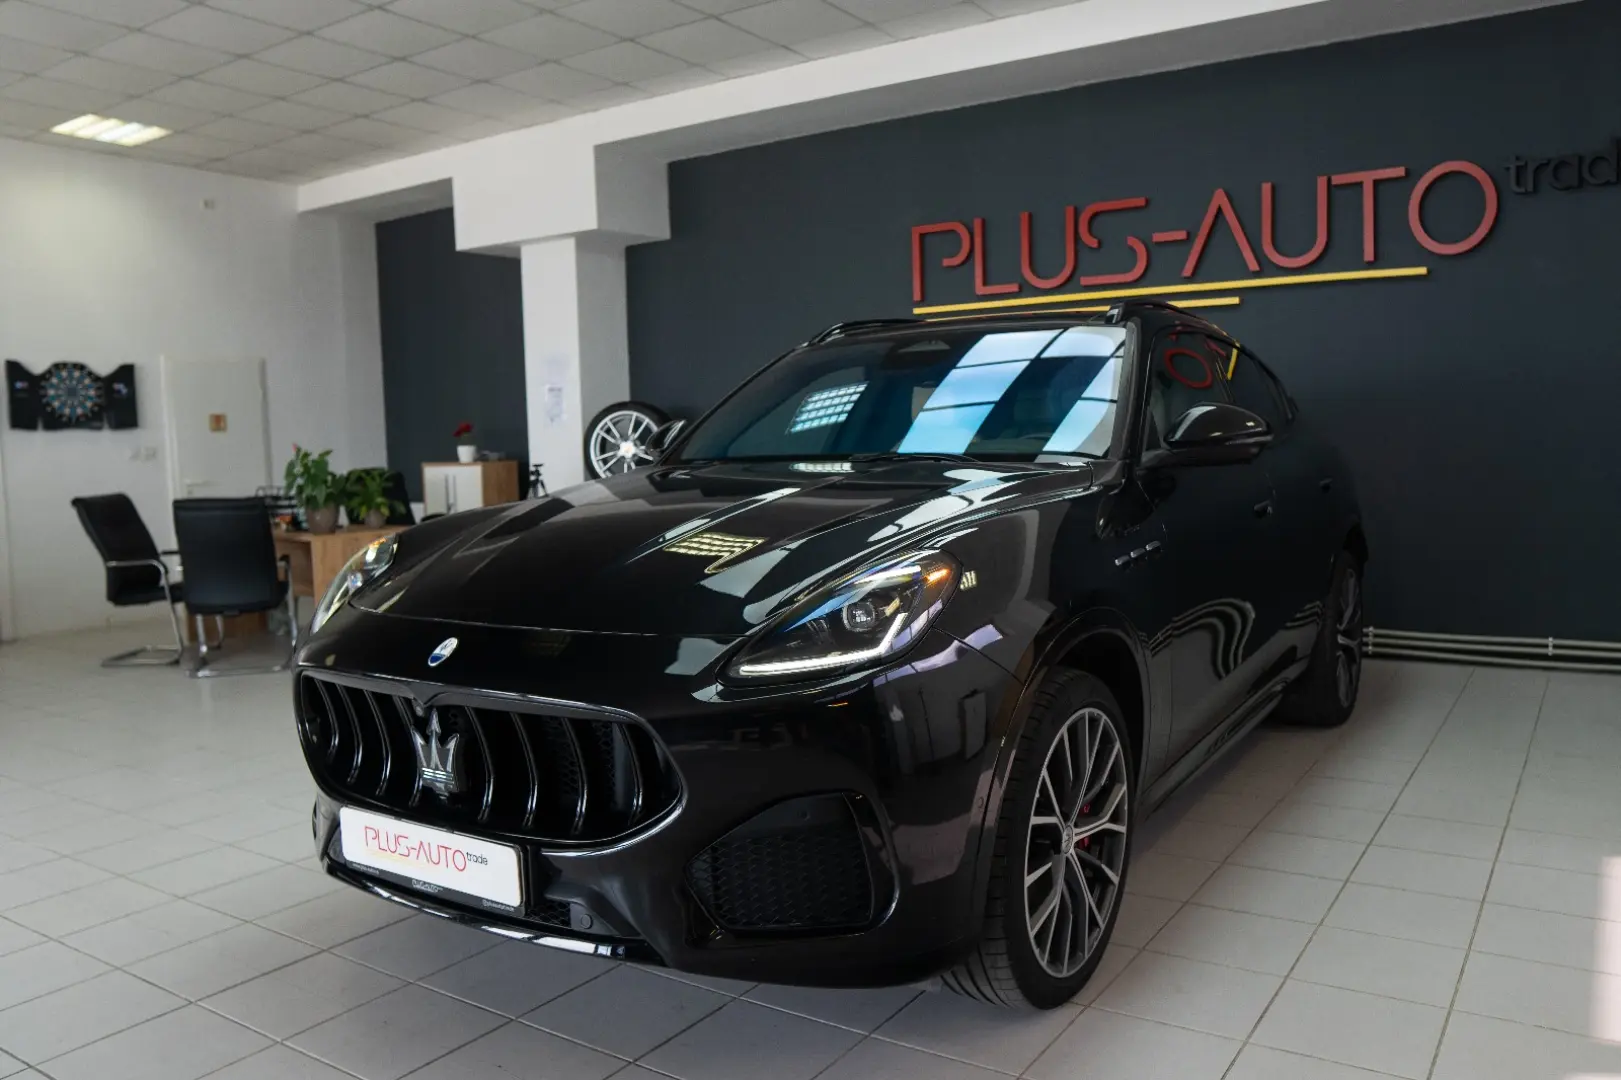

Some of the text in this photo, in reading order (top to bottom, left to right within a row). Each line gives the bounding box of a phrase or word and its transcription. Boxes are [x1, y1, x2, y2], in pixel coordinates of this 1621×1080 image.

[911, 160, 1498, 301] PLUS-AUTO
[364, 826, 488, 872] PLUS-AUTO trade
